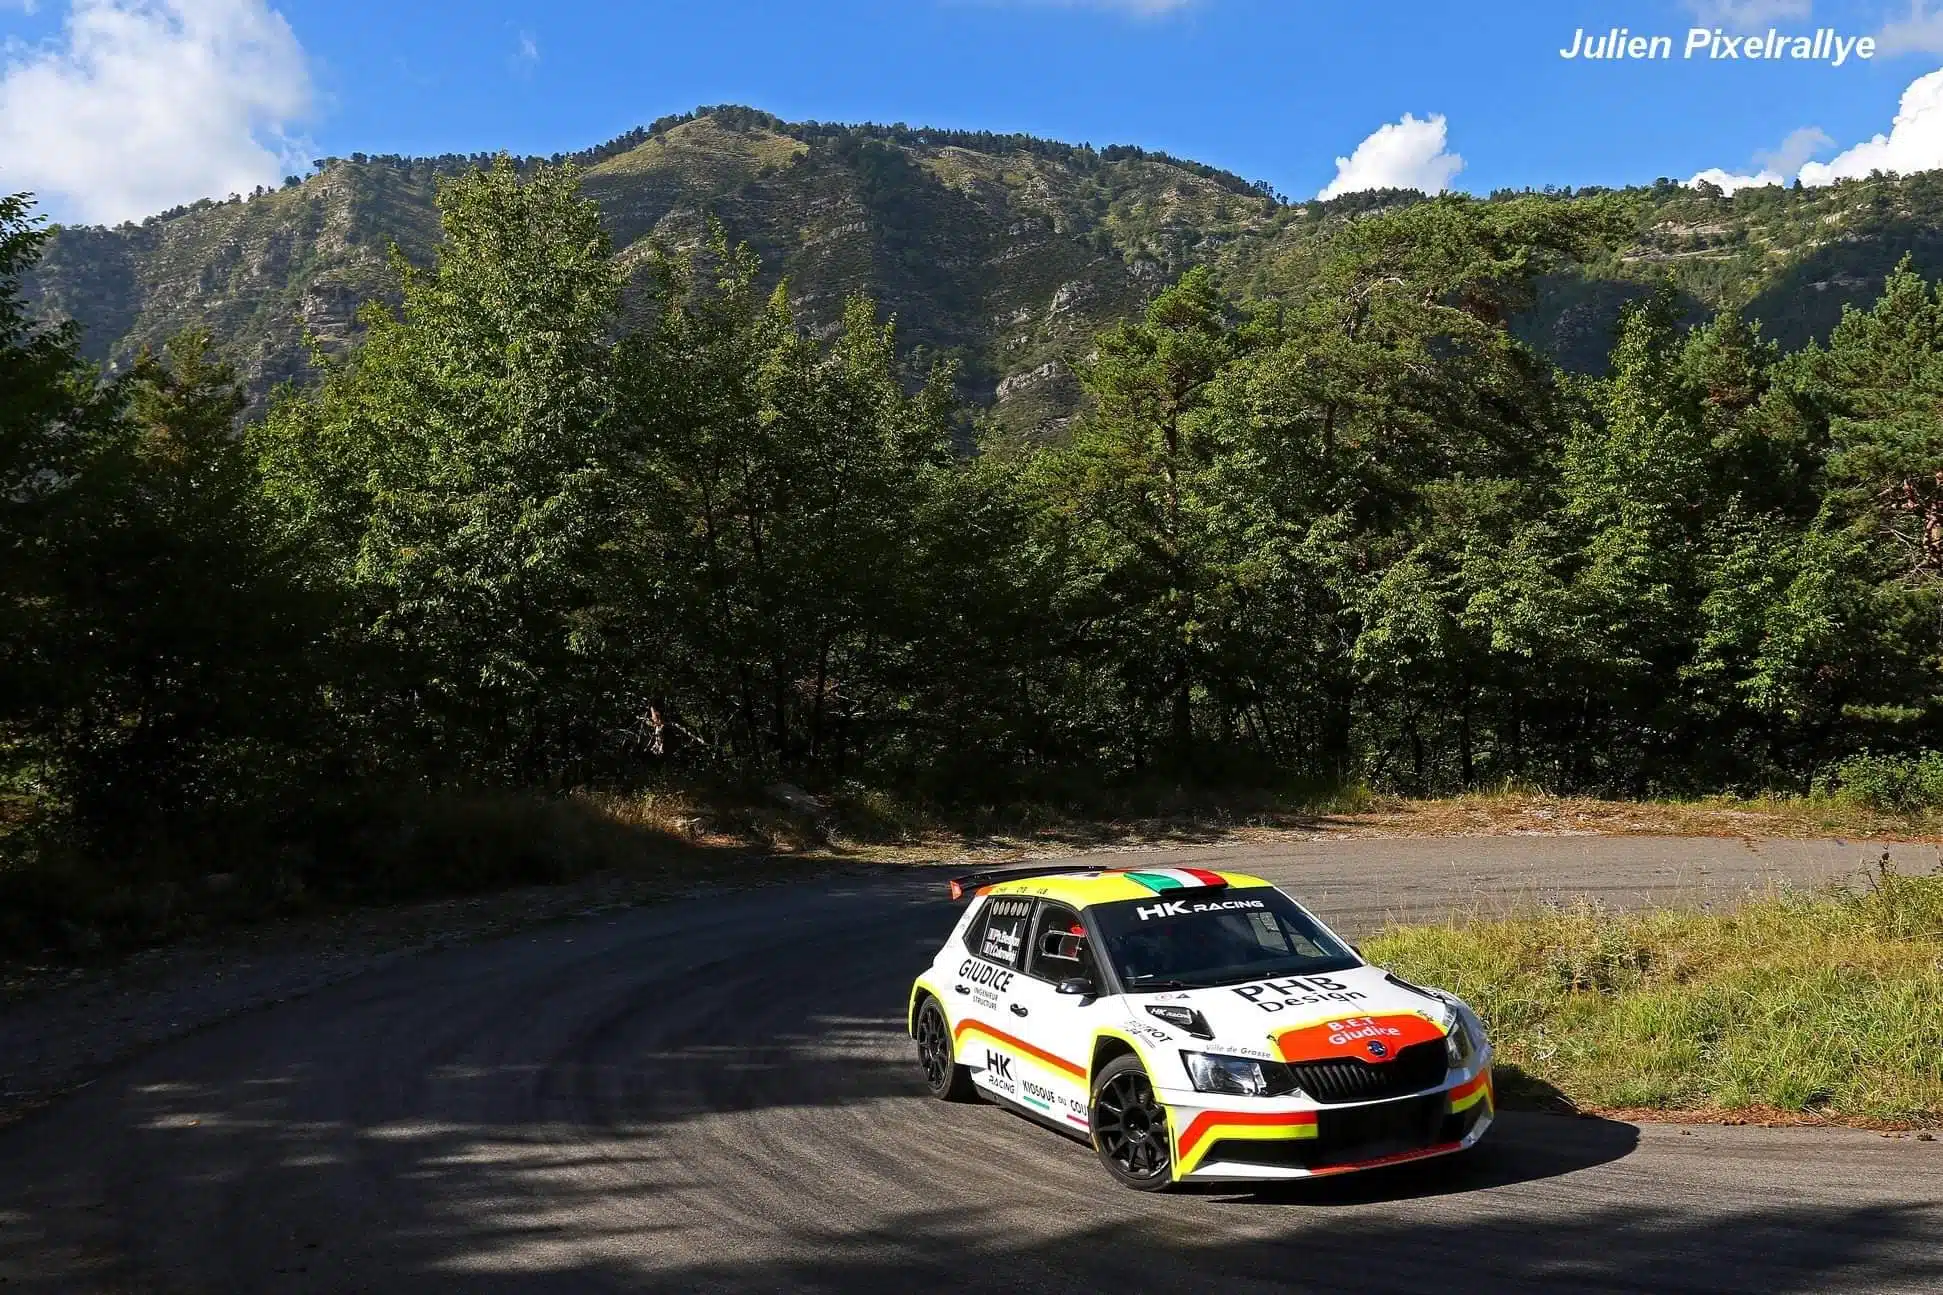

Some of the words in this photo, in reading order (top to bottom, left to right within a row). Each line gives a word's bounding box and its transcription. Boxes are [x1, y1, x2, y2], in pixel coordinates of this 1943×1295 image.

[1136, 900, 1192, 921] HK
[1193, 900, 1265, 912] RACING
[959, 958, 1014, 992] GIUDICE
[1231, 976, 1347, 1003] PHB
[1151, 1007, 1167, 1016] HK
[1257, 990, 1367, 1013] Design
[1328, 1025, 1401, 1045] Giudice
[1206, 1044, 1225, 1053] Ville
[1226, 1045, 1238, 1053] de
[1240, 1047, 1271, 1058] Grasse
[987, 1048, 1013, 1080] HK
[988, 1074, 1015, 1094] RACING
[1022, 1079, 1055, 1103] KIOSQUE
[1070, 1099, 1089, 1117] COU
